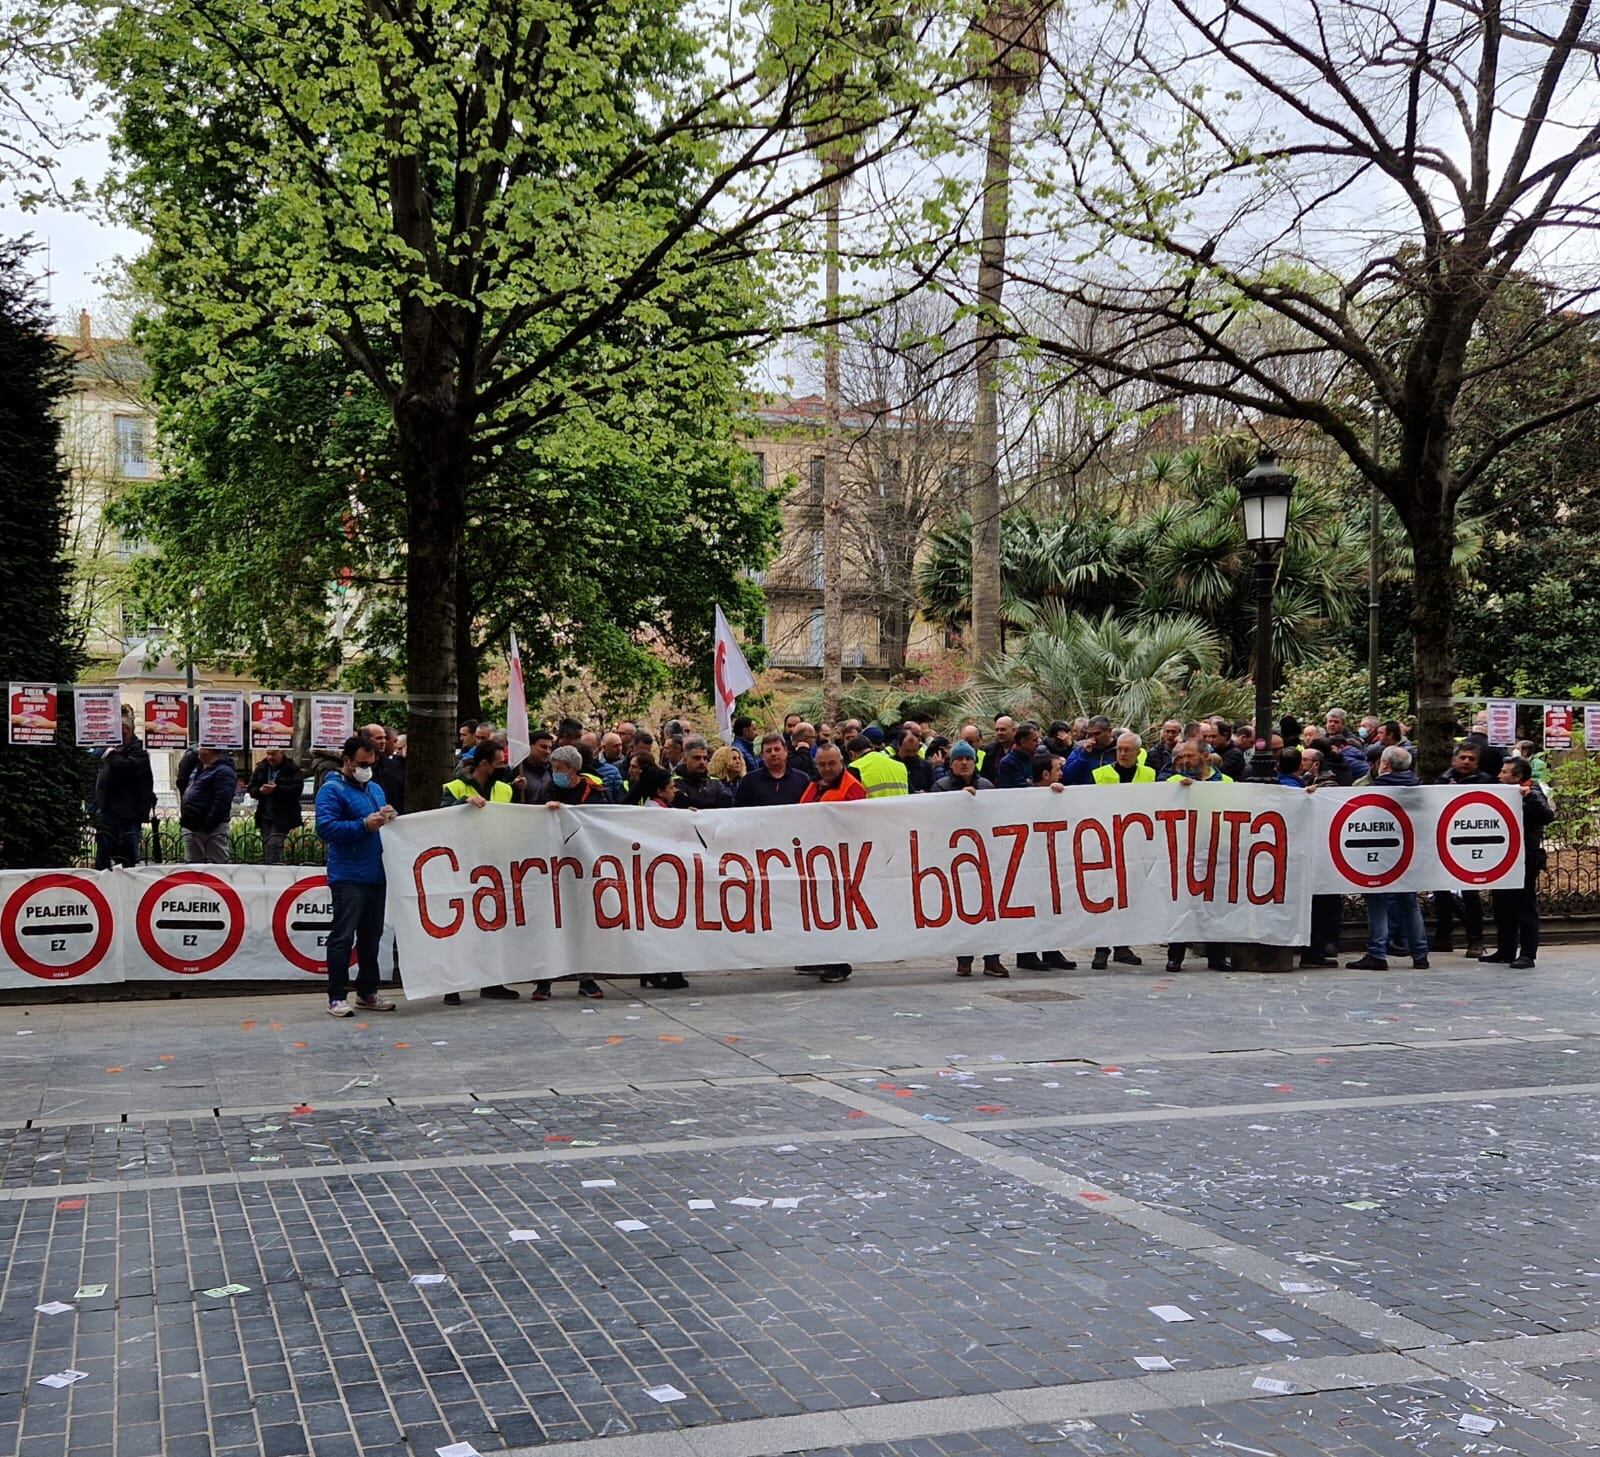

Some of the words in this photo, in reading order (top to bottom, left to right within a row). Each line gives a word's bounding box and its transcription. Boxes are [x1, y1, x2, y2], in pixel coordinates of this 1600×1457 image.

[1348, 821, 1396, 833] PEAJERIK
[1454, 819, 1500, 830] PEAJERIK
[1367, 851, 1379, 863] EZ
[1471, 849, 1483, 860] EZ
[26, 904, 89, 918] PEAJERIK
[161, 901, 221, 914] PEAJERIK
[296, 903, 333, 914] PEAJE
[50, 939, 67, 952] EZ
[182, 935, 198, 947] EZ
